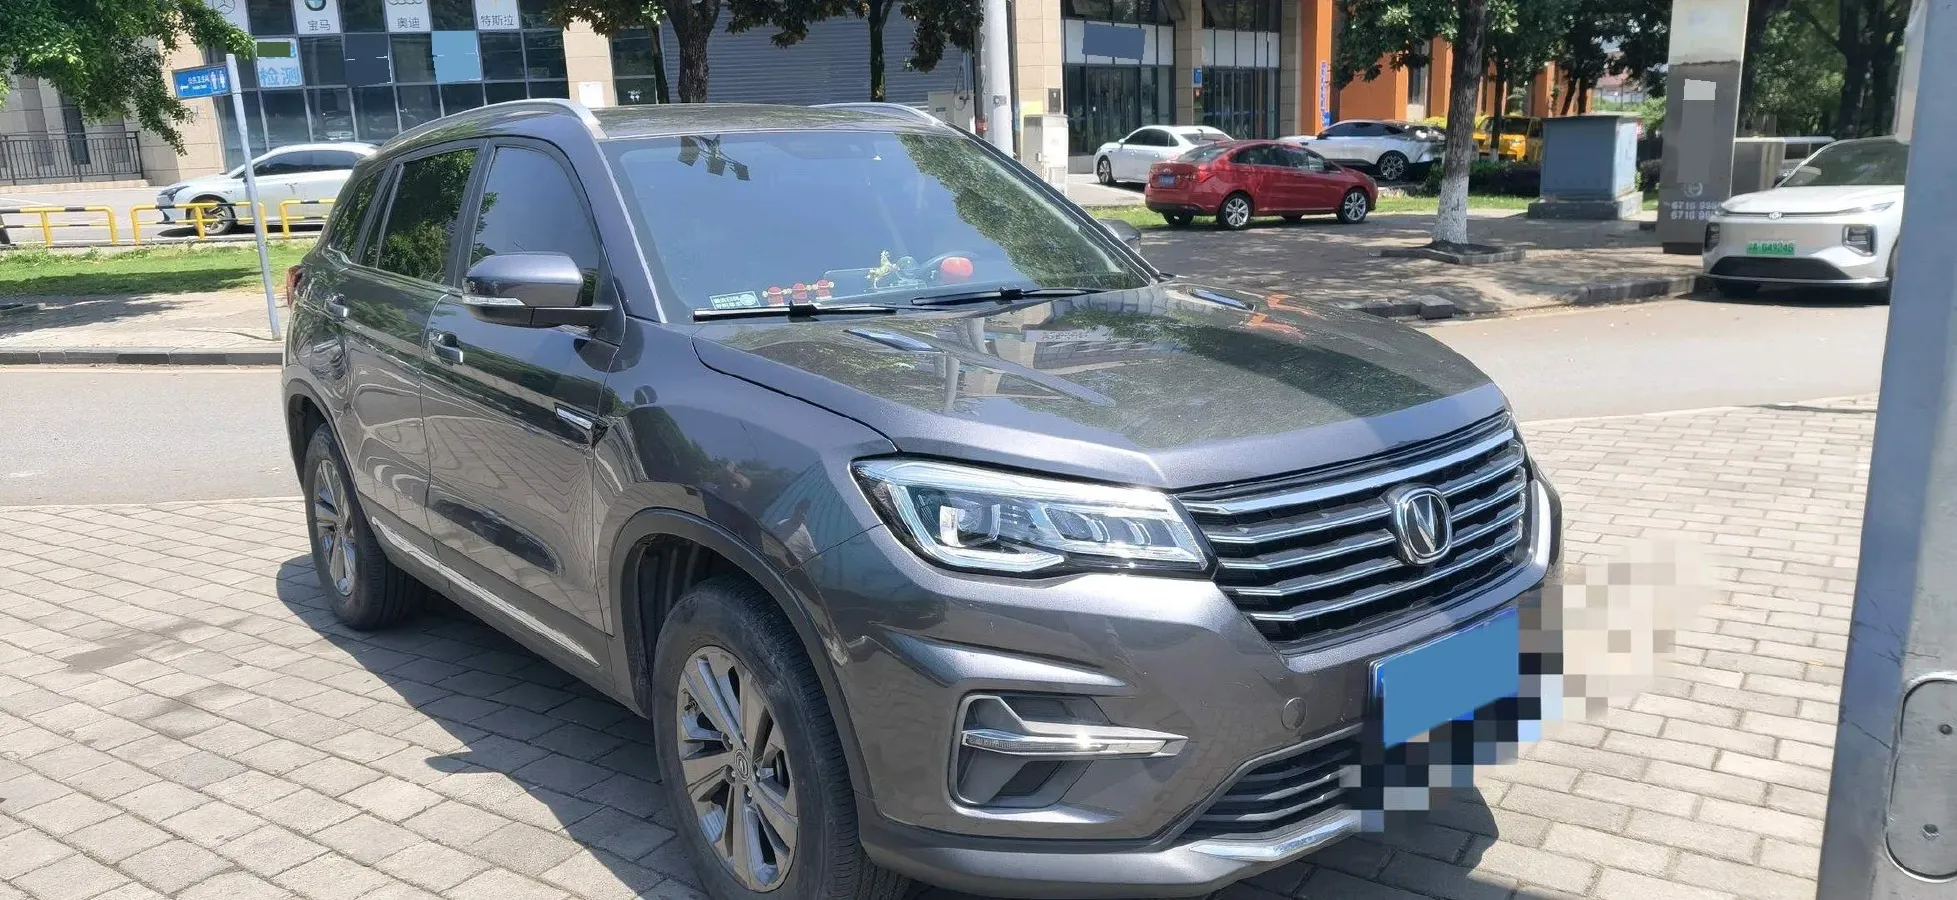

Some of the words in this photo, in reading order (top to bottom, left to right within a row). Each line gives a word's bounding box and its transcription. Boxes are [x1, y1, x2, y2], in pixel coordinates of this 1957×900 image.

[308, 19, 331, 31] 宝马
[397, 17, 421, 29] 奥迪
[481, 14, 514, 26] 特斯拉
[260, 66, 300, 86] 检测
